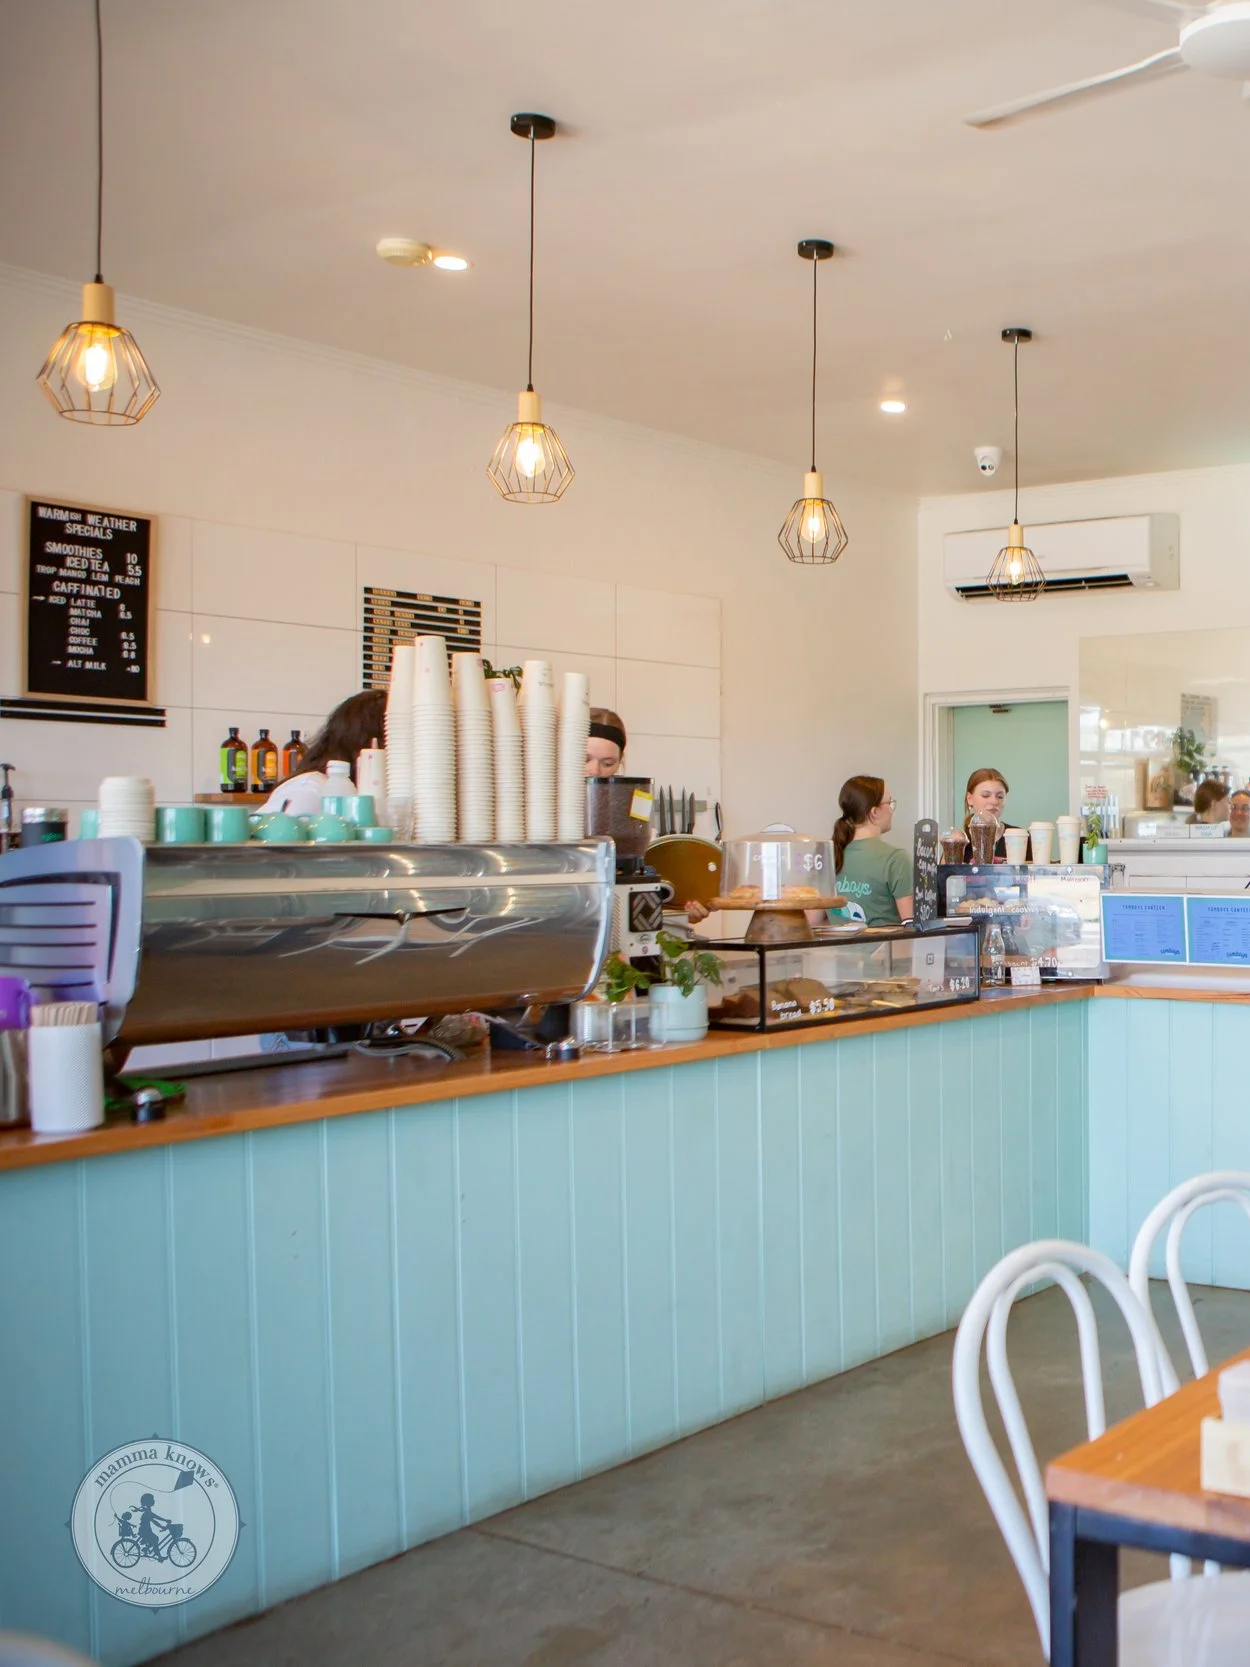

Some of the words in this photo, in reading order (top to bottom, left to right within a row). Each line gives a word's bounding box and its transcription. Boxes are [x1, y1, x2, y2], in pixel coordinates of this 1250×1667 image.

[86, 513, 137, 532] WEATHER
[65, 522, 113, 540] SPECIALS
[45, 541, 103, 560] SMOOTHIES
[126, 552, 138, 564] 10
[65, 556, 89, 570] ICED
[90, 560, 110, 573] TEA
[59, 568, 87, 579] MANGO
[115, 574, 141, 586] PEACH
[52, 581, 121, 600] CAFFINATED
[48, 595, 67, 605] ICED
[70, 597, 96, 609] LATTE
[69, 607, 102, 619] MATCHA
[69, 617, 90, 626] CHAI
[69, 626, 91, 636] CHOC
[68, 636, 99, 646] COFFEE
[67, 645, 95, 656] MOCHA
[66, 659, 83, 669] ALT
[84, 660, 107, 671] MILK
[803, 853, 823, 872] $6
[969, 904, 1005, 918] Indulgent
[949, 975, 970, 992] $6.20
[771, 999, 798, 1011] Banana
[809, 997, 835, 1016] $5.50
[780, 1008, 802, 1020] bread
